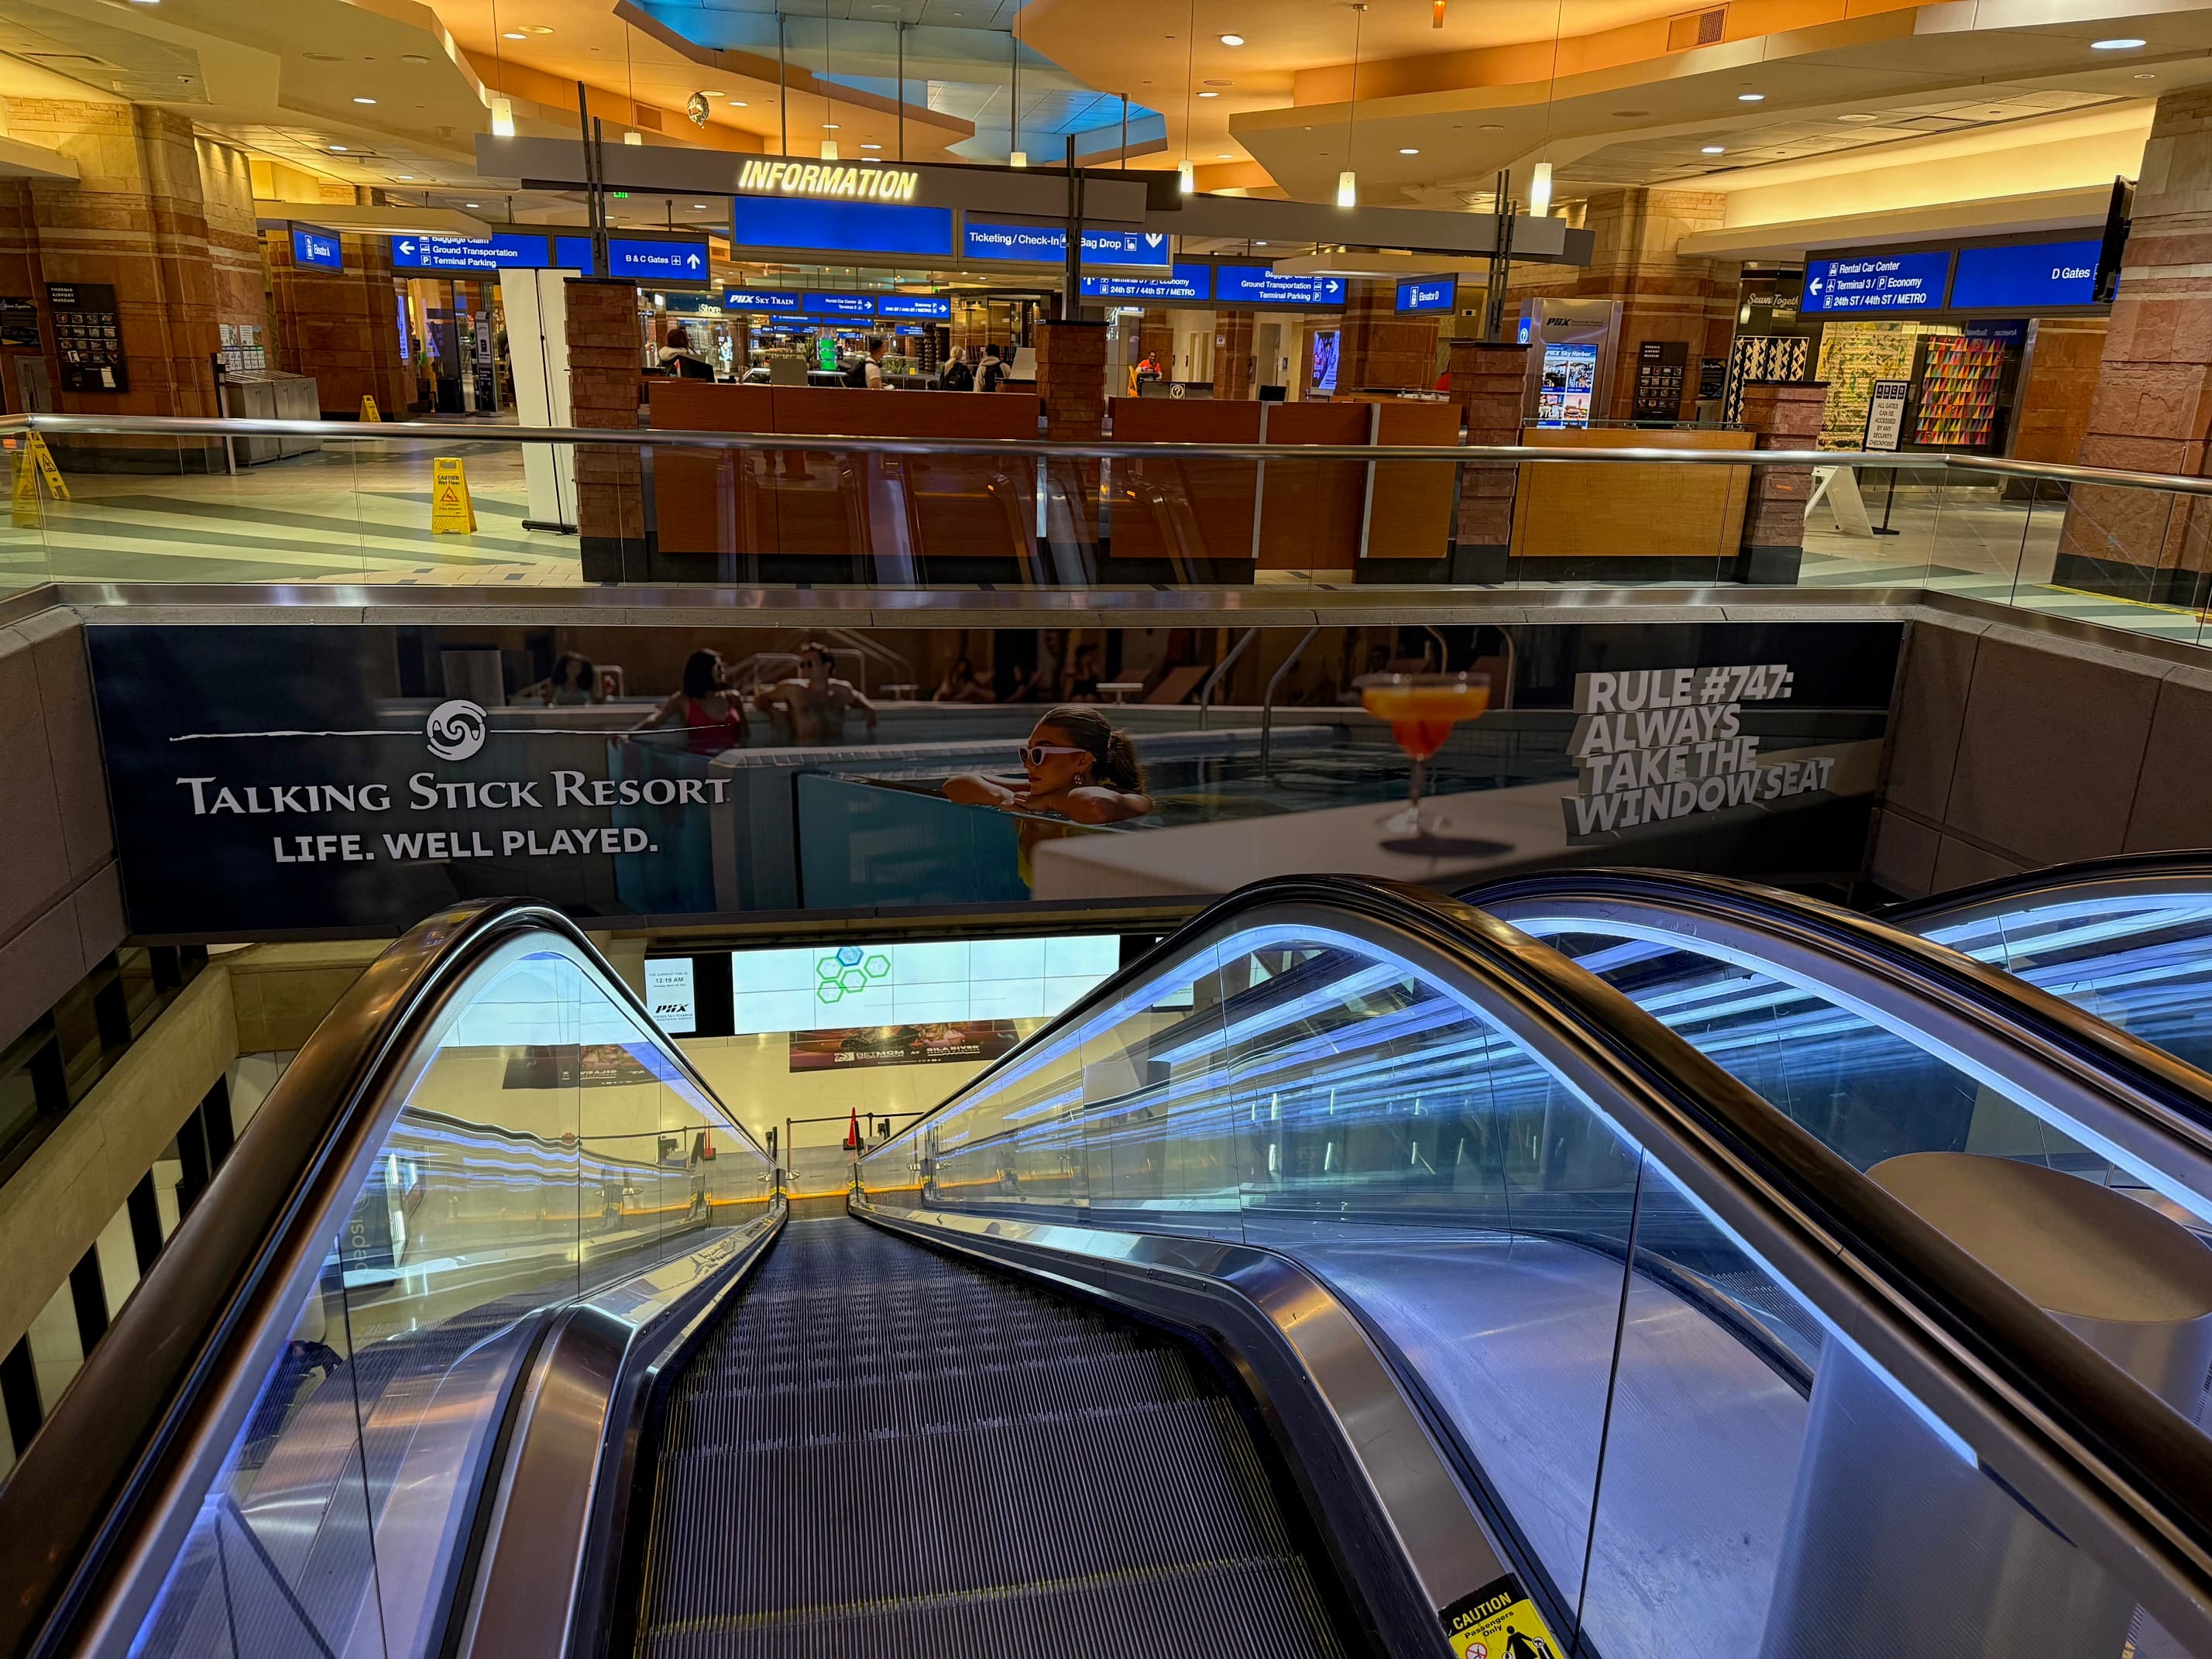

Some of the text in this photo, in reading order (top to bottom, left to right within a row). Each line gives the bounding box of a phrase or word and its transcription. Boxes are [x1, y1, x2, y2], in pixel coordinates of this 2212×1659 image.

[738, 160, 918, 198] INFORMATION
[970, 232, 1121, 249] Ticketing / Check-In Bag Drop
[433, 246, 518, 257] Ground Transportation
[433, 256, 465, 265] Terminal
[468, 258, 496, 268] Parking
[1839, 261, 1900, 273] Rental Car Center
[2052, 268, 2090, 280] D Gates
[1266, 281, 1311, 290] Transportation
[1836, 280, 1864, 290] Terminal
[1866, 280, 1870, 289] 3
[1871, 279, 1876, 288] /
[1887, 277, 1922, 288] Economy
[730, 295, 794, 305] PHX SKY TRAIN
[1287, 292, 1311, 301] Parking
[1419, 292, 1435, 301] Elevator
[1747, 293, 1771, 304] Sewn
[1833, 293, 1927, 306] 24th ST / 44th ST / METRO
[699, 304, 721, 314] iStore
[1546, 318, 1571, 326] PHX
[1588, 664, 1795, 713] RULE #747:
[1579, 703, 1741, 757] ALWAYS
[1586, 737, 1760, 796] TAKE THE
[176, 776, 391, 816] TALKING
[409, 772, 543, 812] STICK
[1574, 757, 1835, 836] WINDOW SEAT
[273, 828, 658, 863] LIFE. WELL PLAYED.
[655, 1004, 689, 1013] PHX
[1452, 1592, 1512, 1630] CAUTION
[1464, 1610, 1514, 1639] Passengers
[1482, 1624, 1503, 1637] Only
